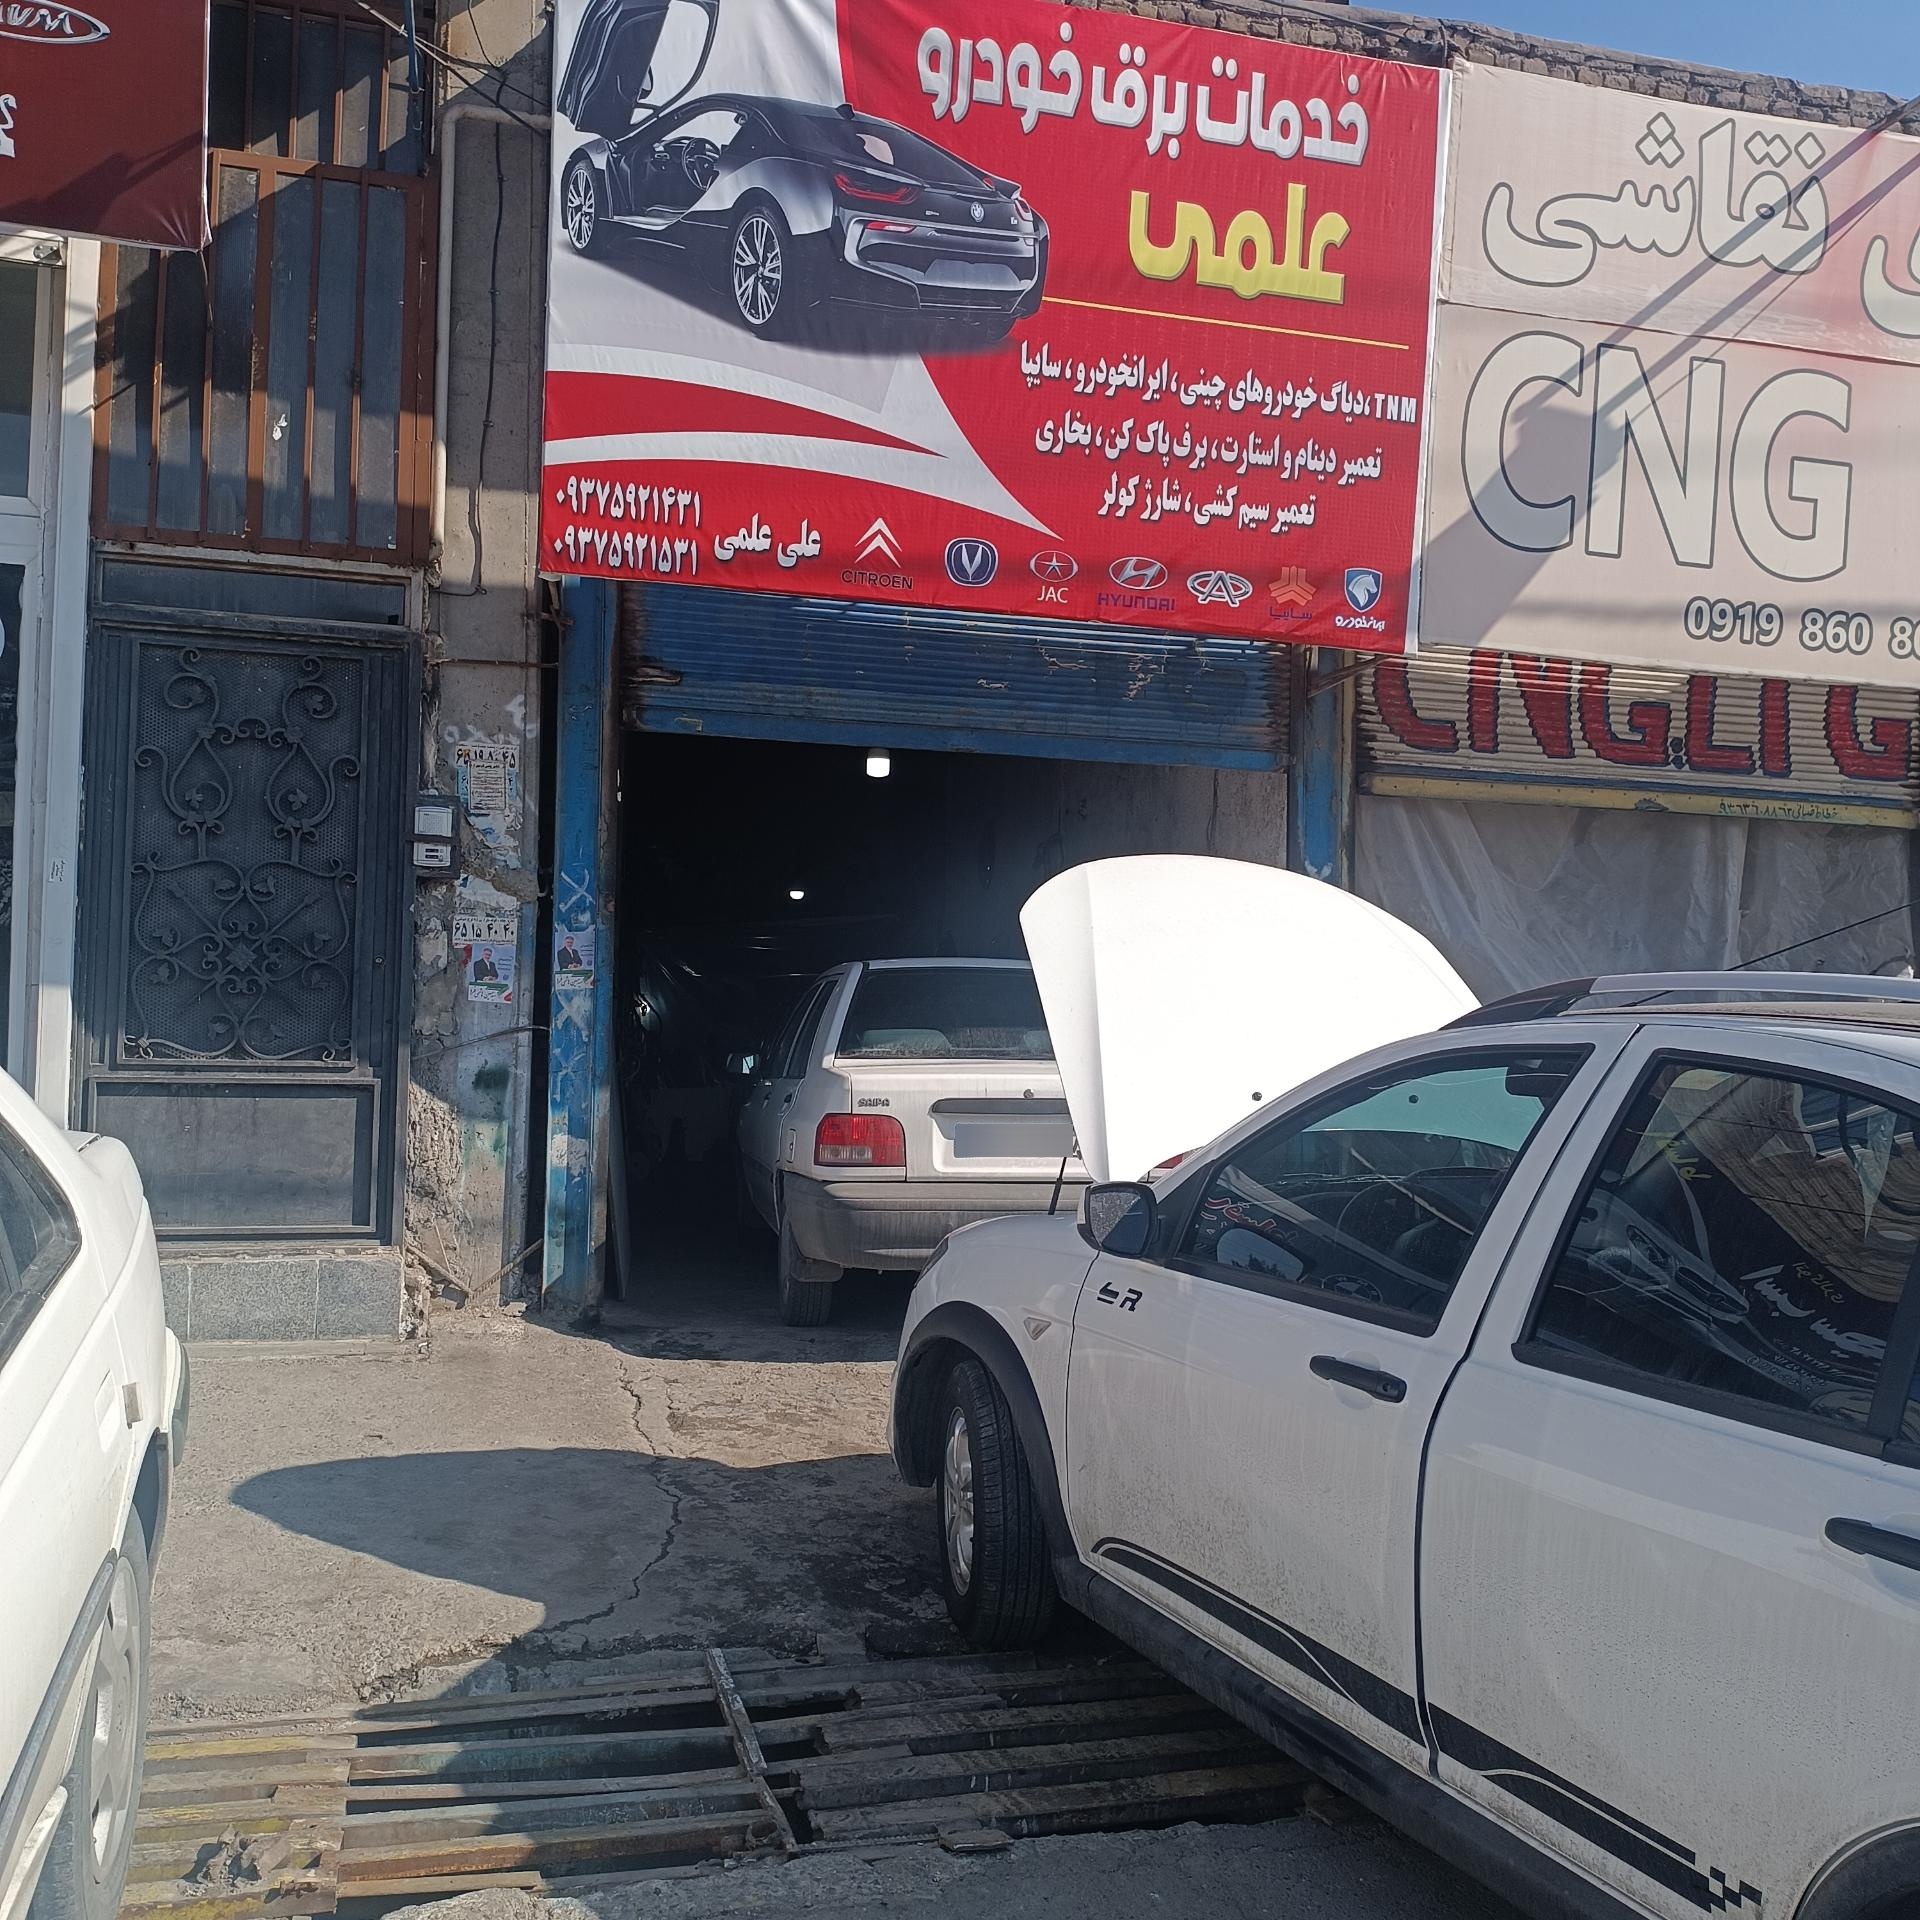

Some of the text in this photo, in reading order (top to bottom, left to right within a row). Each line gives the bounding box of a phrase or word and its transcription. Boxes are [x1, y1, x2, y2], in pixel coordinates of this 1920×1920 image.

[917, 21, 1370, 166] خدمات برق خودرو
[1482, 111, 1830, 287] نقاشی
[1129, 182, 1351, 305] علمی
[1020, 340, 1062, 390] سایپا
[1229, 368, 1318, 419] خودروهای
[1375, 392, 1417, 424] TNM
[1035, 409, 1092, 455] بخاری
[1135, 418, 1171, 468] پاک
[1172, 421, 1209, 470] برف
[1460, 330, 1854, 583] CNG
[1294, 439, 1337, 483] دینام
[1338, 447, 1383, 485] تعمیر
[556, 475, 701, 528] ۰۹۳۷۵۹۲۱۴۳۱
[1097, 470, 1141, 516] کولر
[1141, 476, 1183, 521] شارژ
[1270, 493, 1318, 533] تعمیر
[553, 524, 698, 576] ۰۹۳۷۵۹۲۱۵۳۱
[713, 512, 823, 569] علی علمی
[840, 569, 914, 591] CITROEN
[1036, 585, 1069, 604] JAC
[1096, 592, 1177, 612] HYUNDAI
[1684, 595, 1784, 647] 0919
[1799, 607, 1874, 656] 860
[857, 1097, 891, 1108] SAIPA
